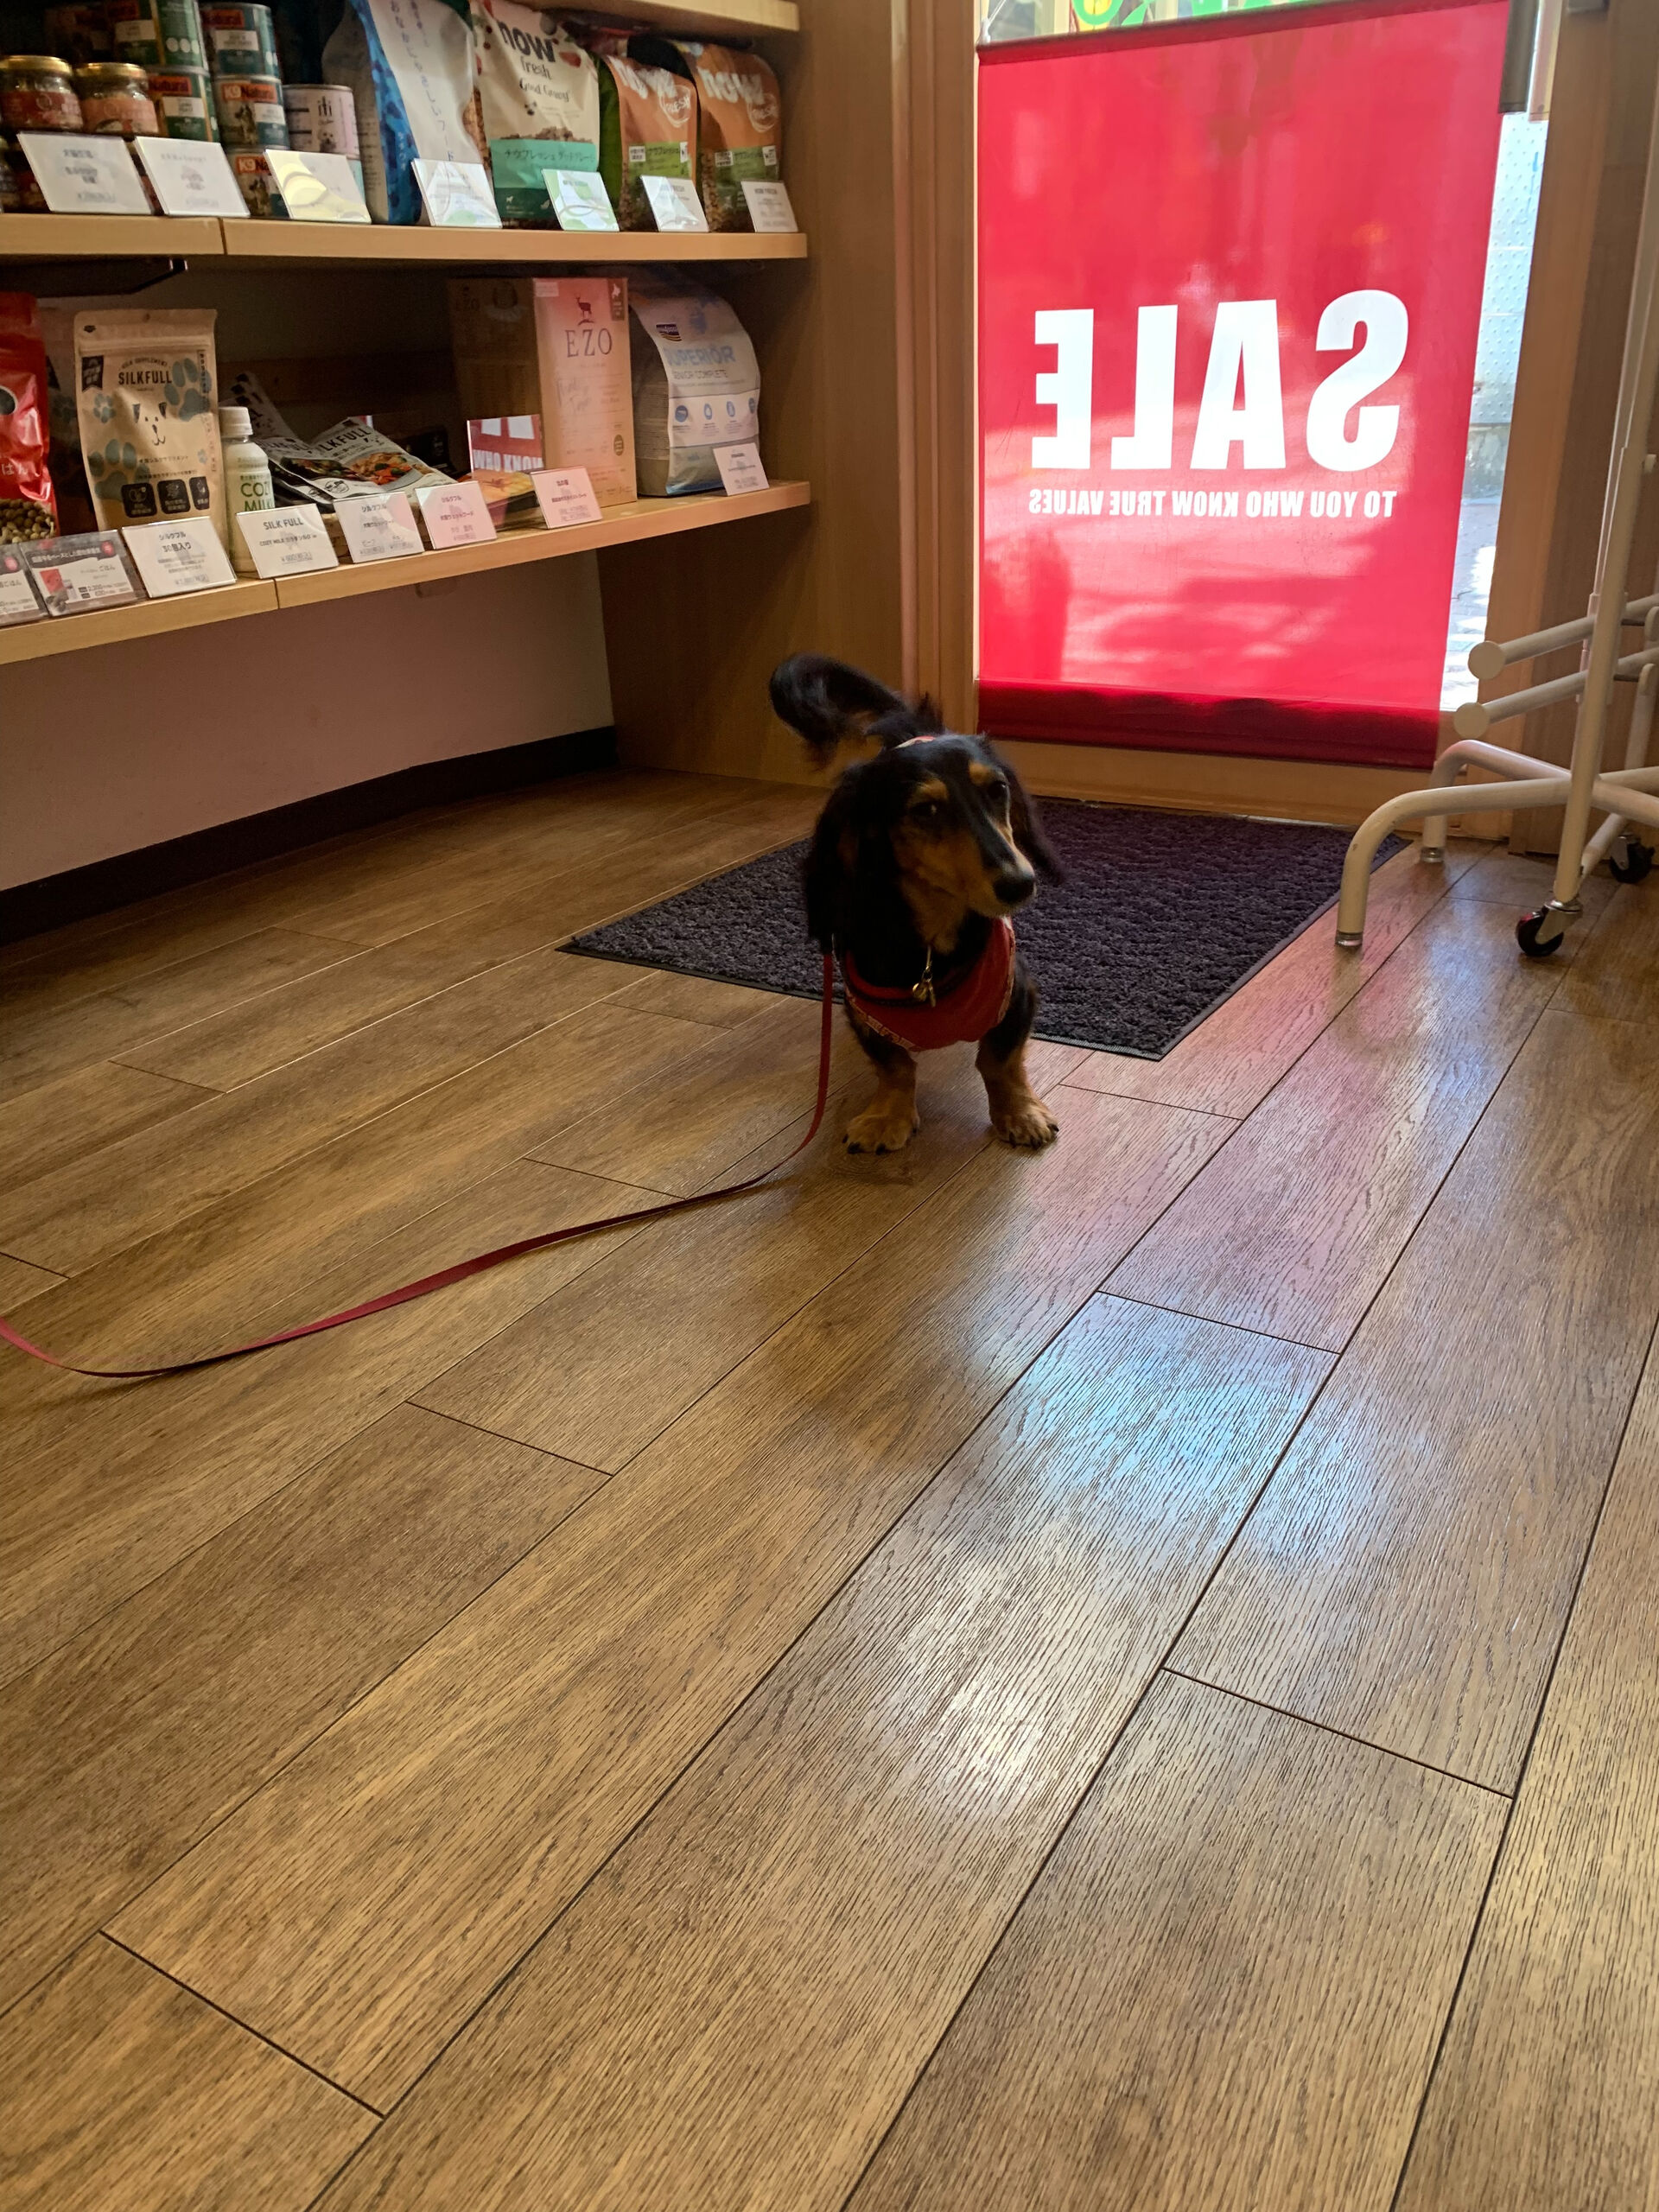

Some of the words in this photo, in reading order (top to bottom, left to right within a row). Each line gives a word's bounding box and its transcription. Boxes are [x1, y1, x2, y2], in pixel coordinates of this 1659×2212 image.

[497, 21, 556, 62] now
[520, 55, 551, 79] fresh
[225, 87, 242, 99] K9
[696, 67, 765, 105] now
[238, 157, 256, 171] K9
[565, 328, 613, 358] EZO
[118, 371, 173, 385] SILKFULL
[315, 428, 372, 453] LKFULL
[263, 519, 283, 531] SILK
[283, 518, 304, 527] FULL
